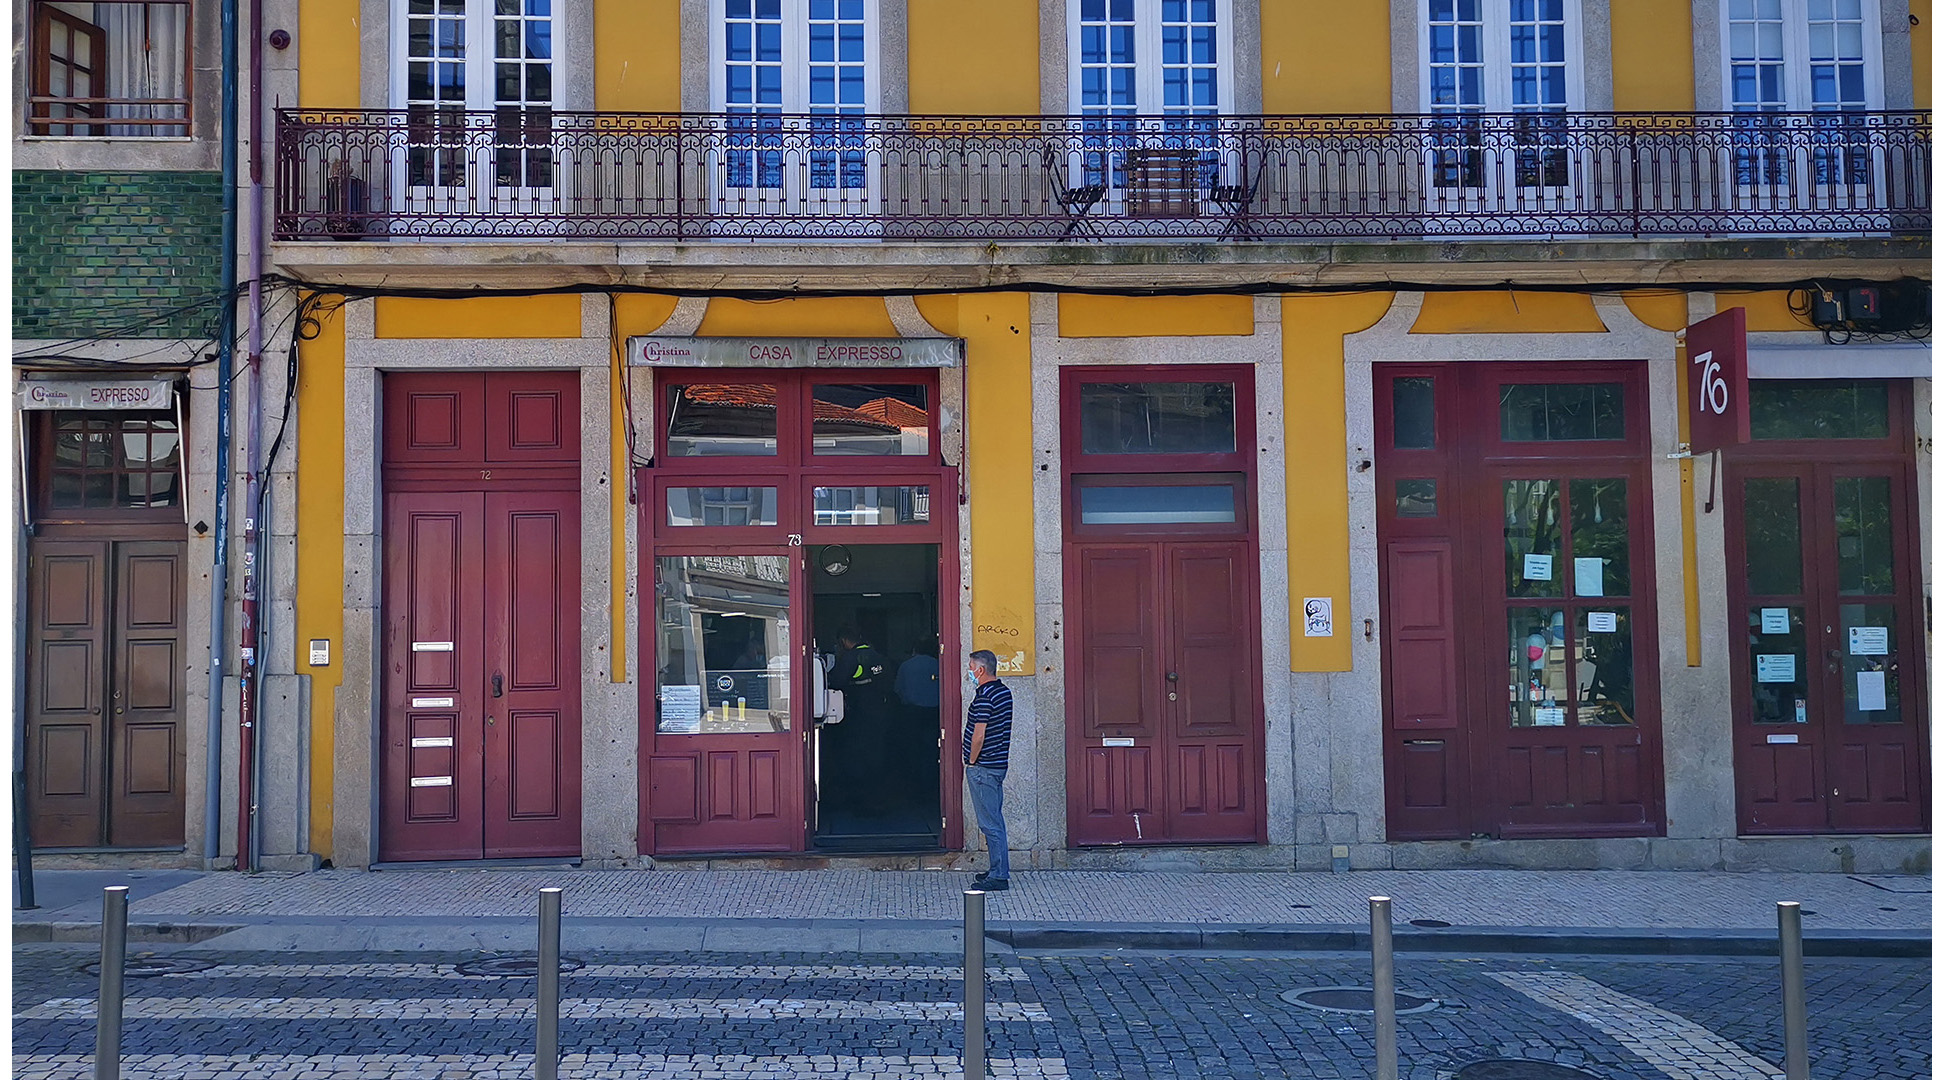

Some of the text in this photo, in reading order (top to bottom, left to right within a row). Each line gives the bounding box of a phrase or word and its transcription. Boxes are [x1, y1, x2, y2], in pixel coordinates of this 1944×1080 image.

[643, 341, 902, 361] Christina CASA EXPRESSO
[1694, 350, 1728, 414] 76
[91, 388, 150, 402] EXPRESSO
[480, 470, 491, 480] 72
[787, 533, 802, 547] 73
